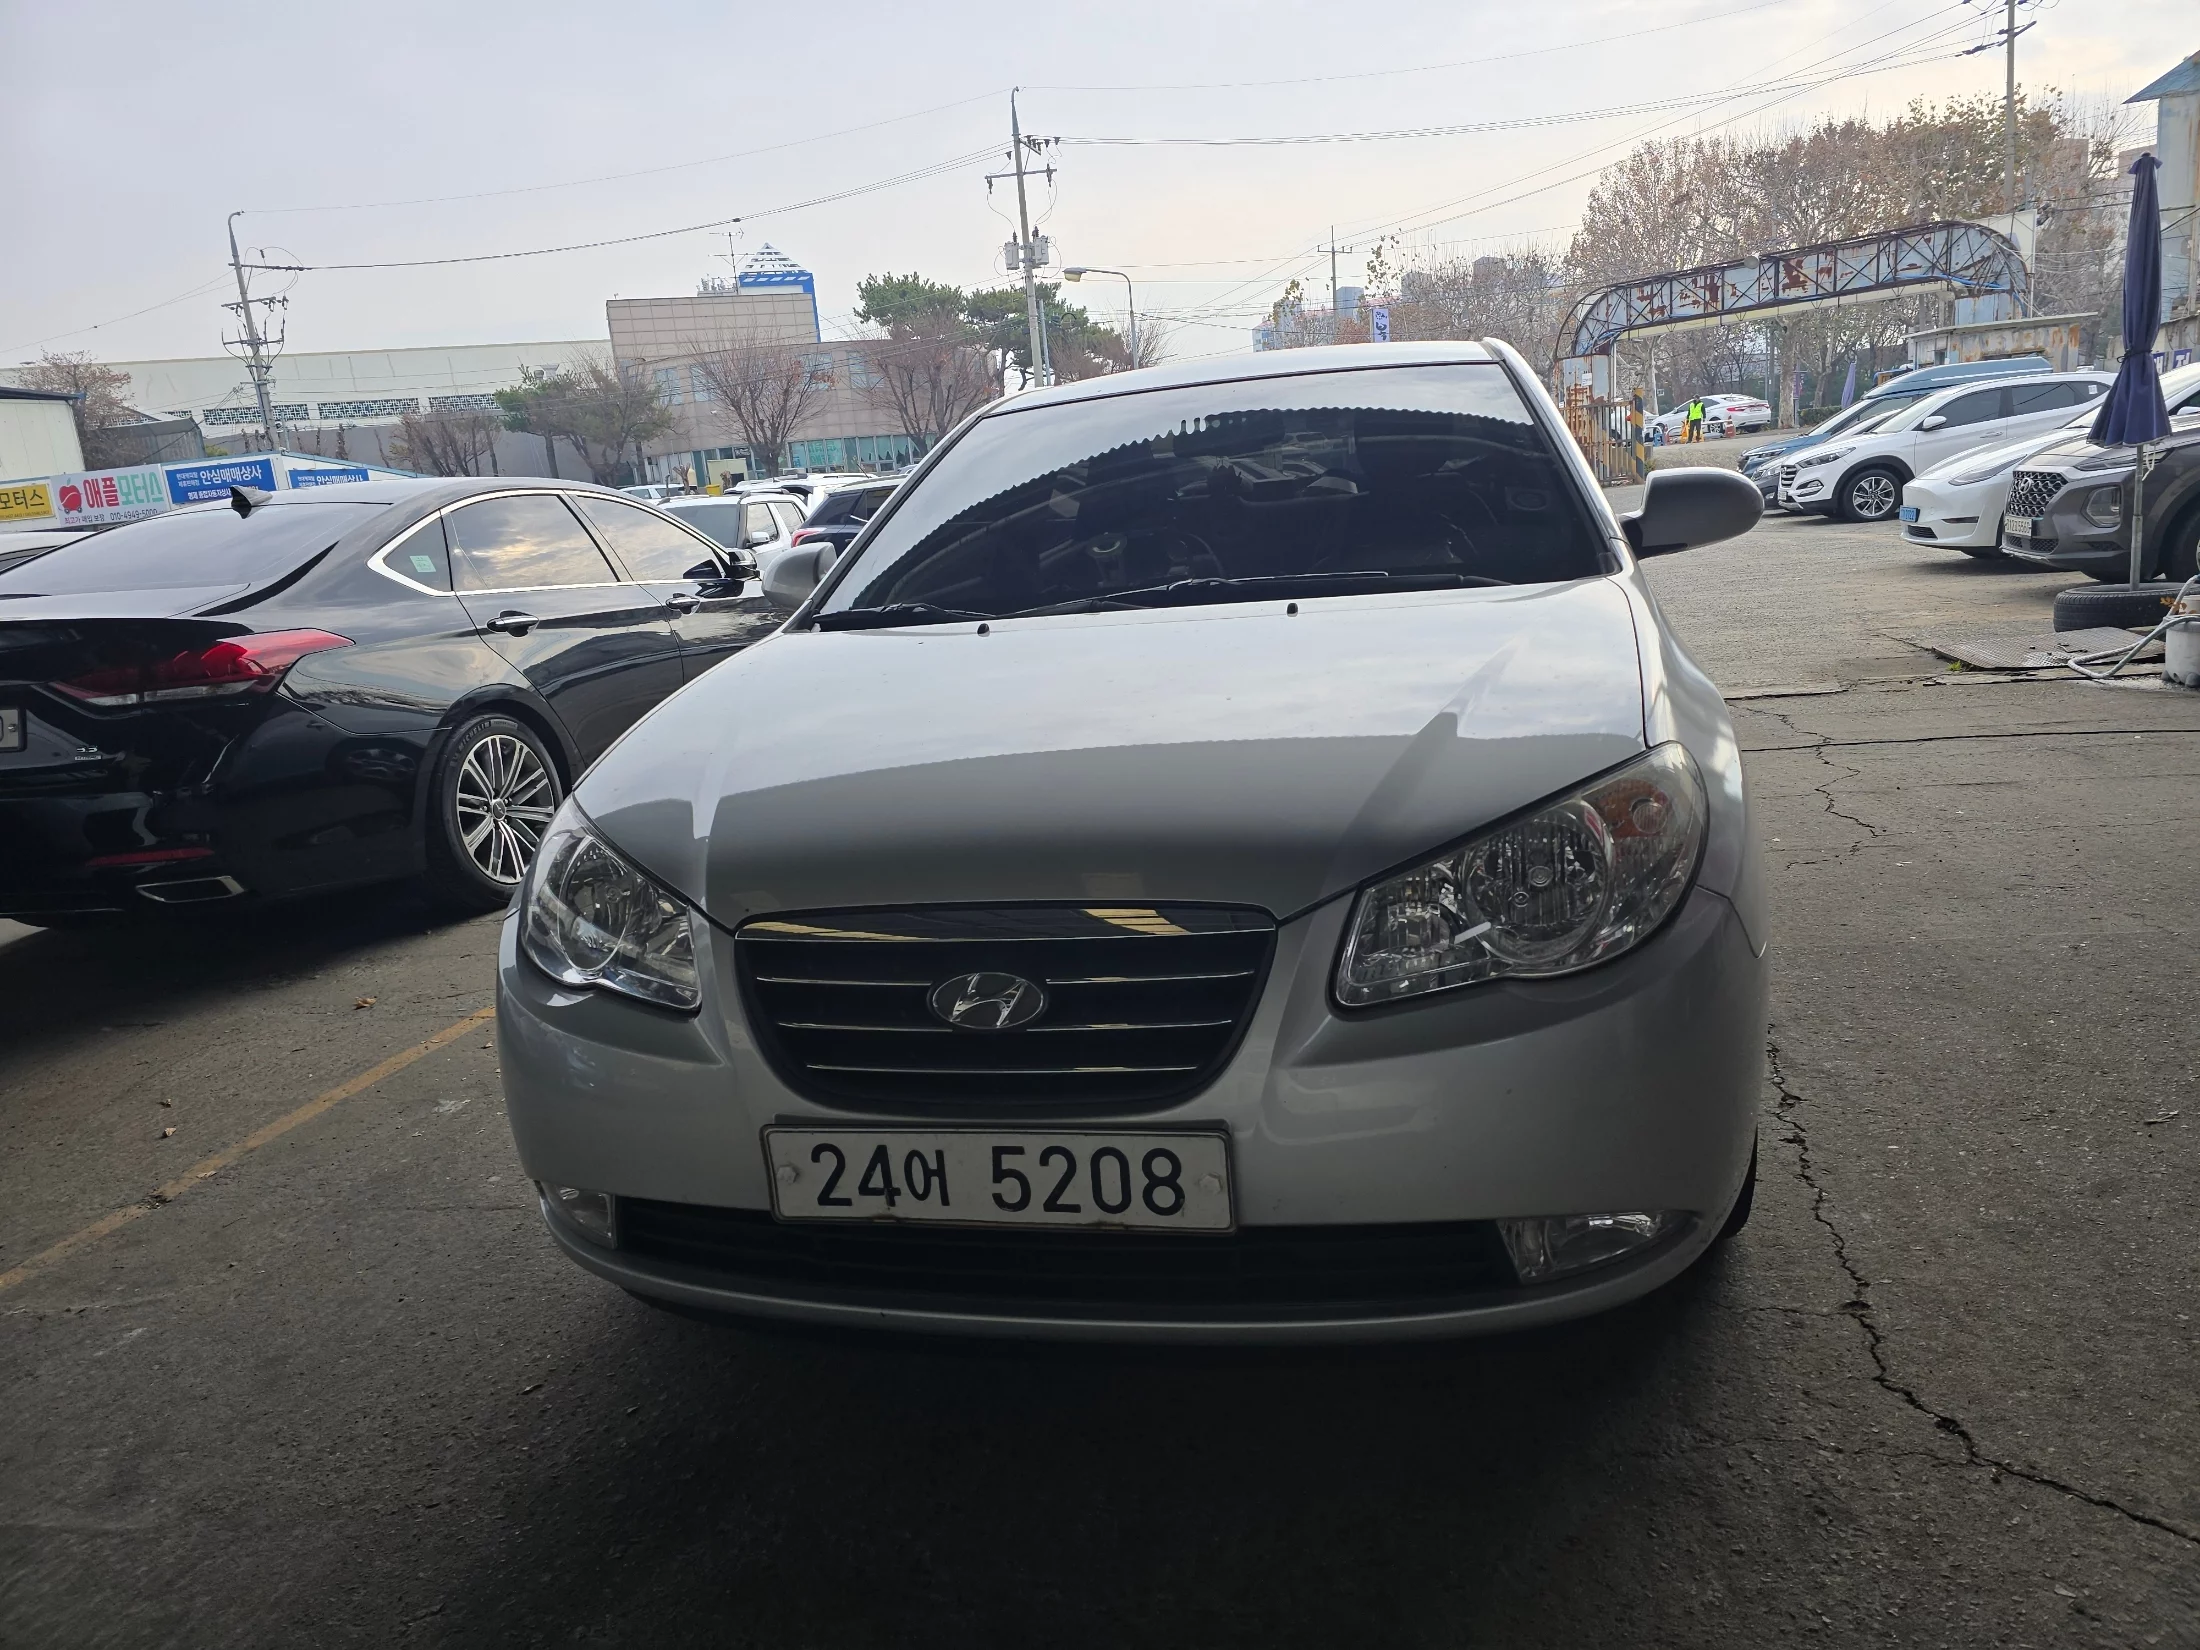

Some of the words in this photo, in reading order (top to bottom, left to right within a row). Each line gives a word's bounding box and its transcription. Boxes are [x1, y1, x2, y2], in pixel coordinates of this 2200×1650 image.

[200, 465, 262, 485] 안심매매상사
[93, 513, 105, 522] 보장
[811, 1142, 950, 1208] 24어
[991, 1145, 1186, 1216] 5208
